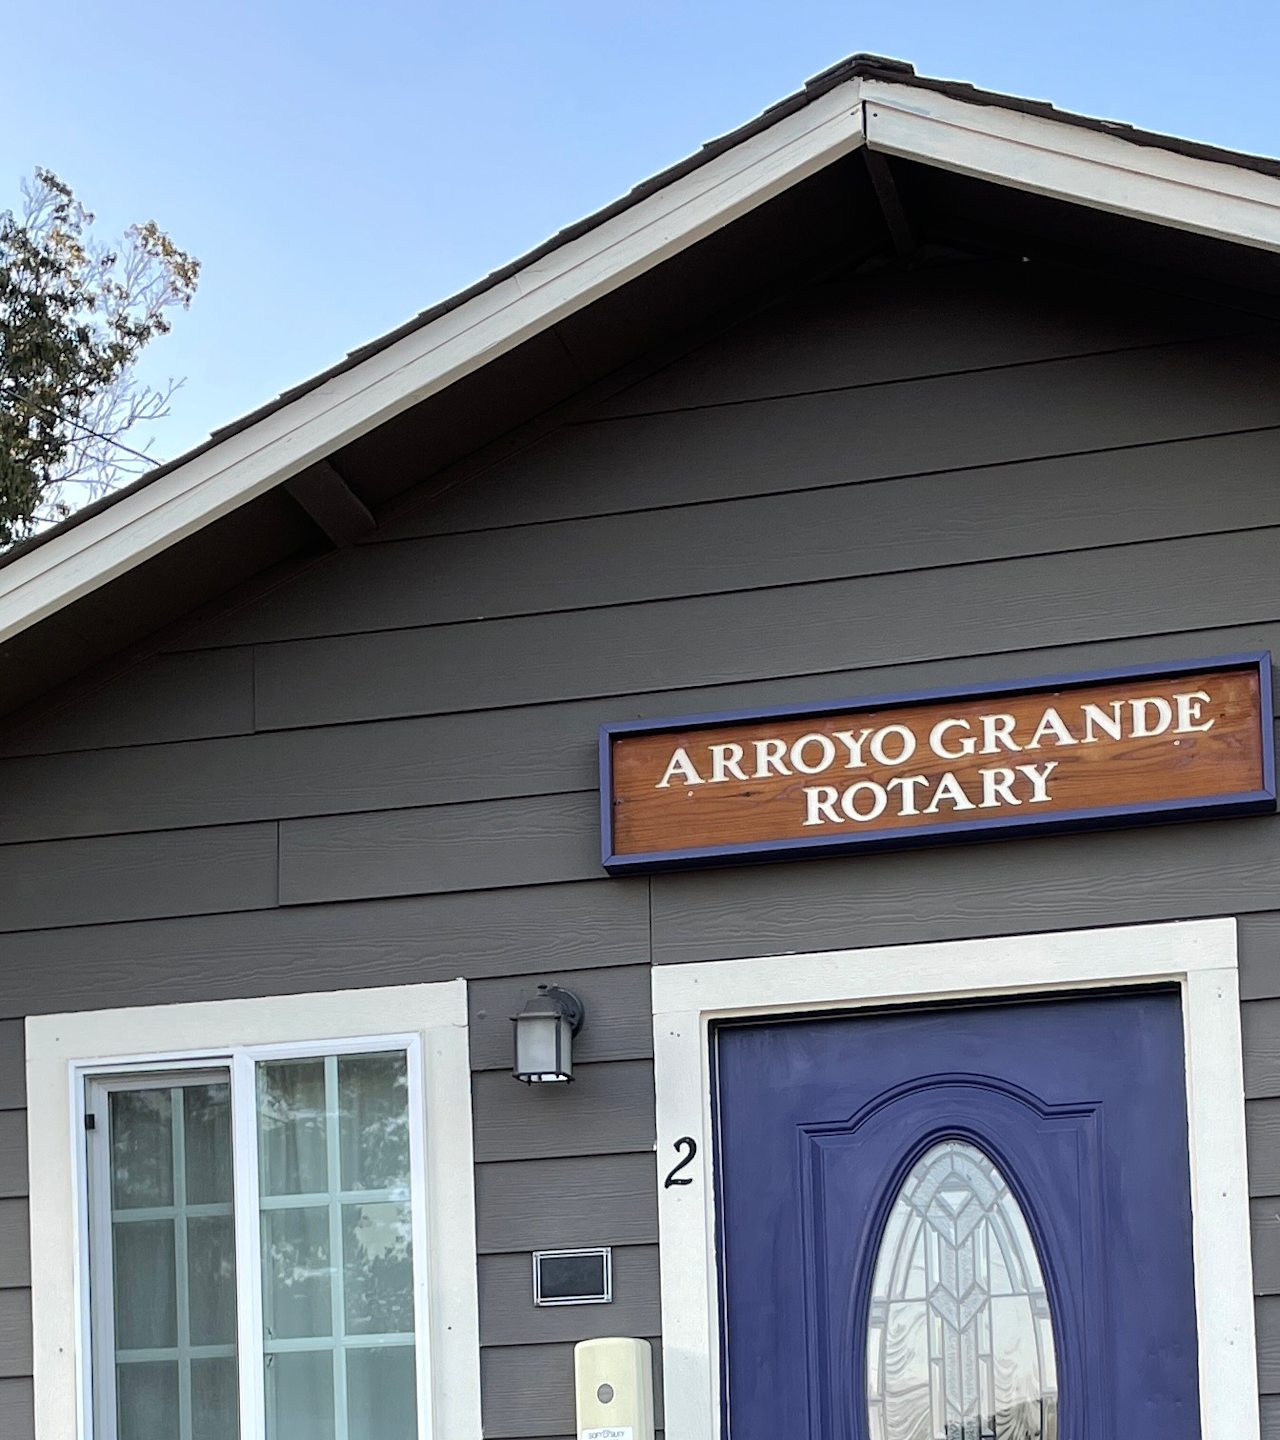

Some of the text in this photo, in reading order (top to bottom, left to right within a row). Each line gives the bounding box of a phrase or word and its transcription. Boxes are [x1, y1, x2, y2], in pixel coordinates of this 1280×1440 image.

[655, 691, 1215, 788] ARROYO GRANDE
[802, 761, 1059, 826] ROTARY
[664, 1136, 697, 1189] 2
